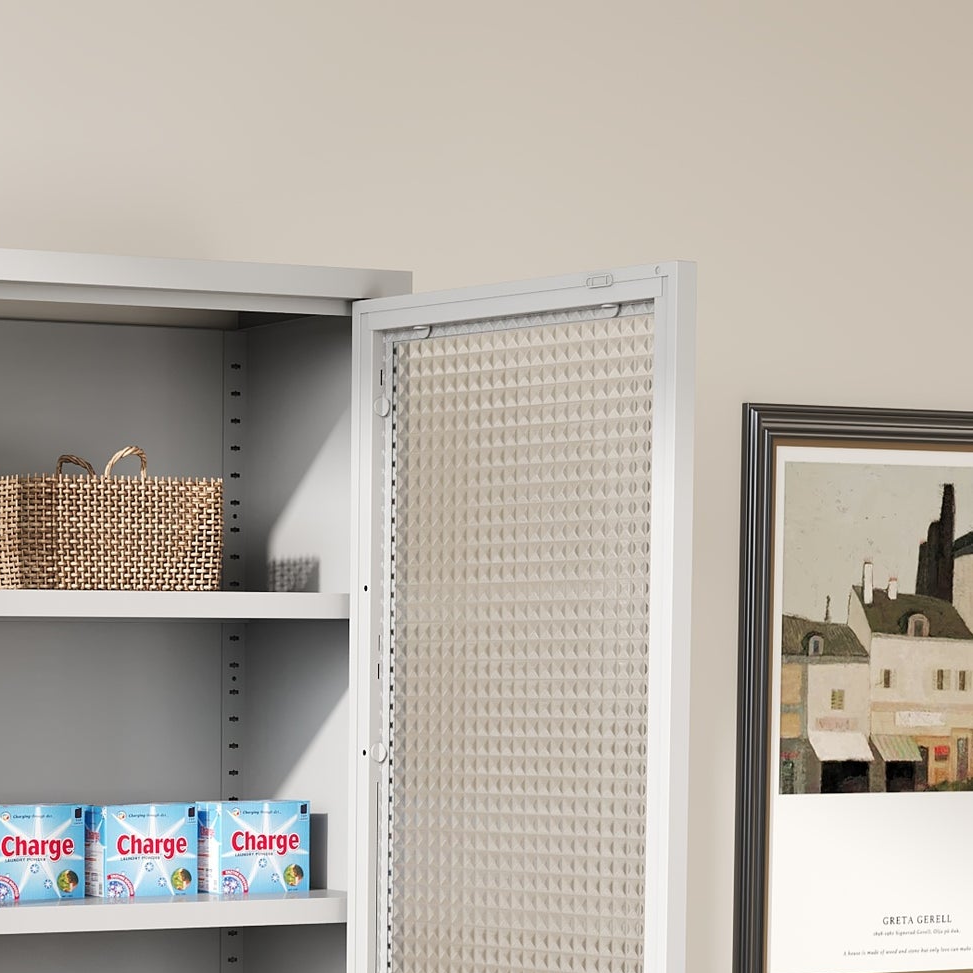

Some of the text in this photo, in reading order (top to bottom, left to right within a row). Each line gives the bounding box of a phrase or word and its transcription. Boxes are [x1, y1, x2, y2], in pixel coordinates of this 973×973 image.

[0, 835, 75, 862] Charge
[116, 834, 188, 860] Charge
[230, 830, 300, 856] Charge
[882, 914, 952, 925] GRETA GERELL
[929, 946, 939, 954] only
